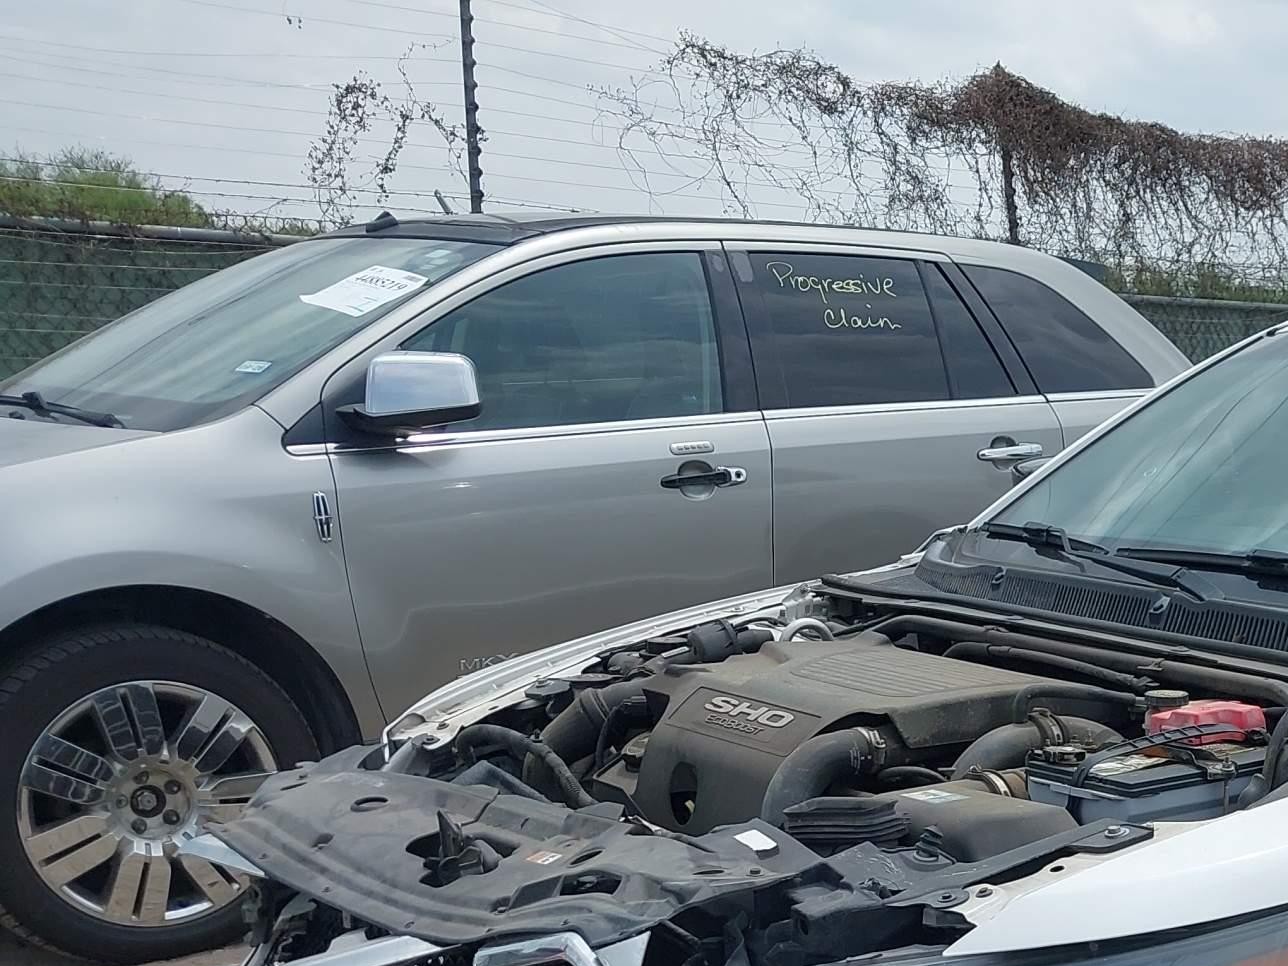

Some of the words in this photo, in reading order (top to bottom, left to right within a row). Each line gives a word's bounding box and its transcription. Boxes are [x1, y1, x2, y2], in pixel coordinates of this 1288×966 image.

[766, 261, 897, 303] Progressive
[823, 303, 902, 329] Claim
[703, 696, 795, 728] SHO
